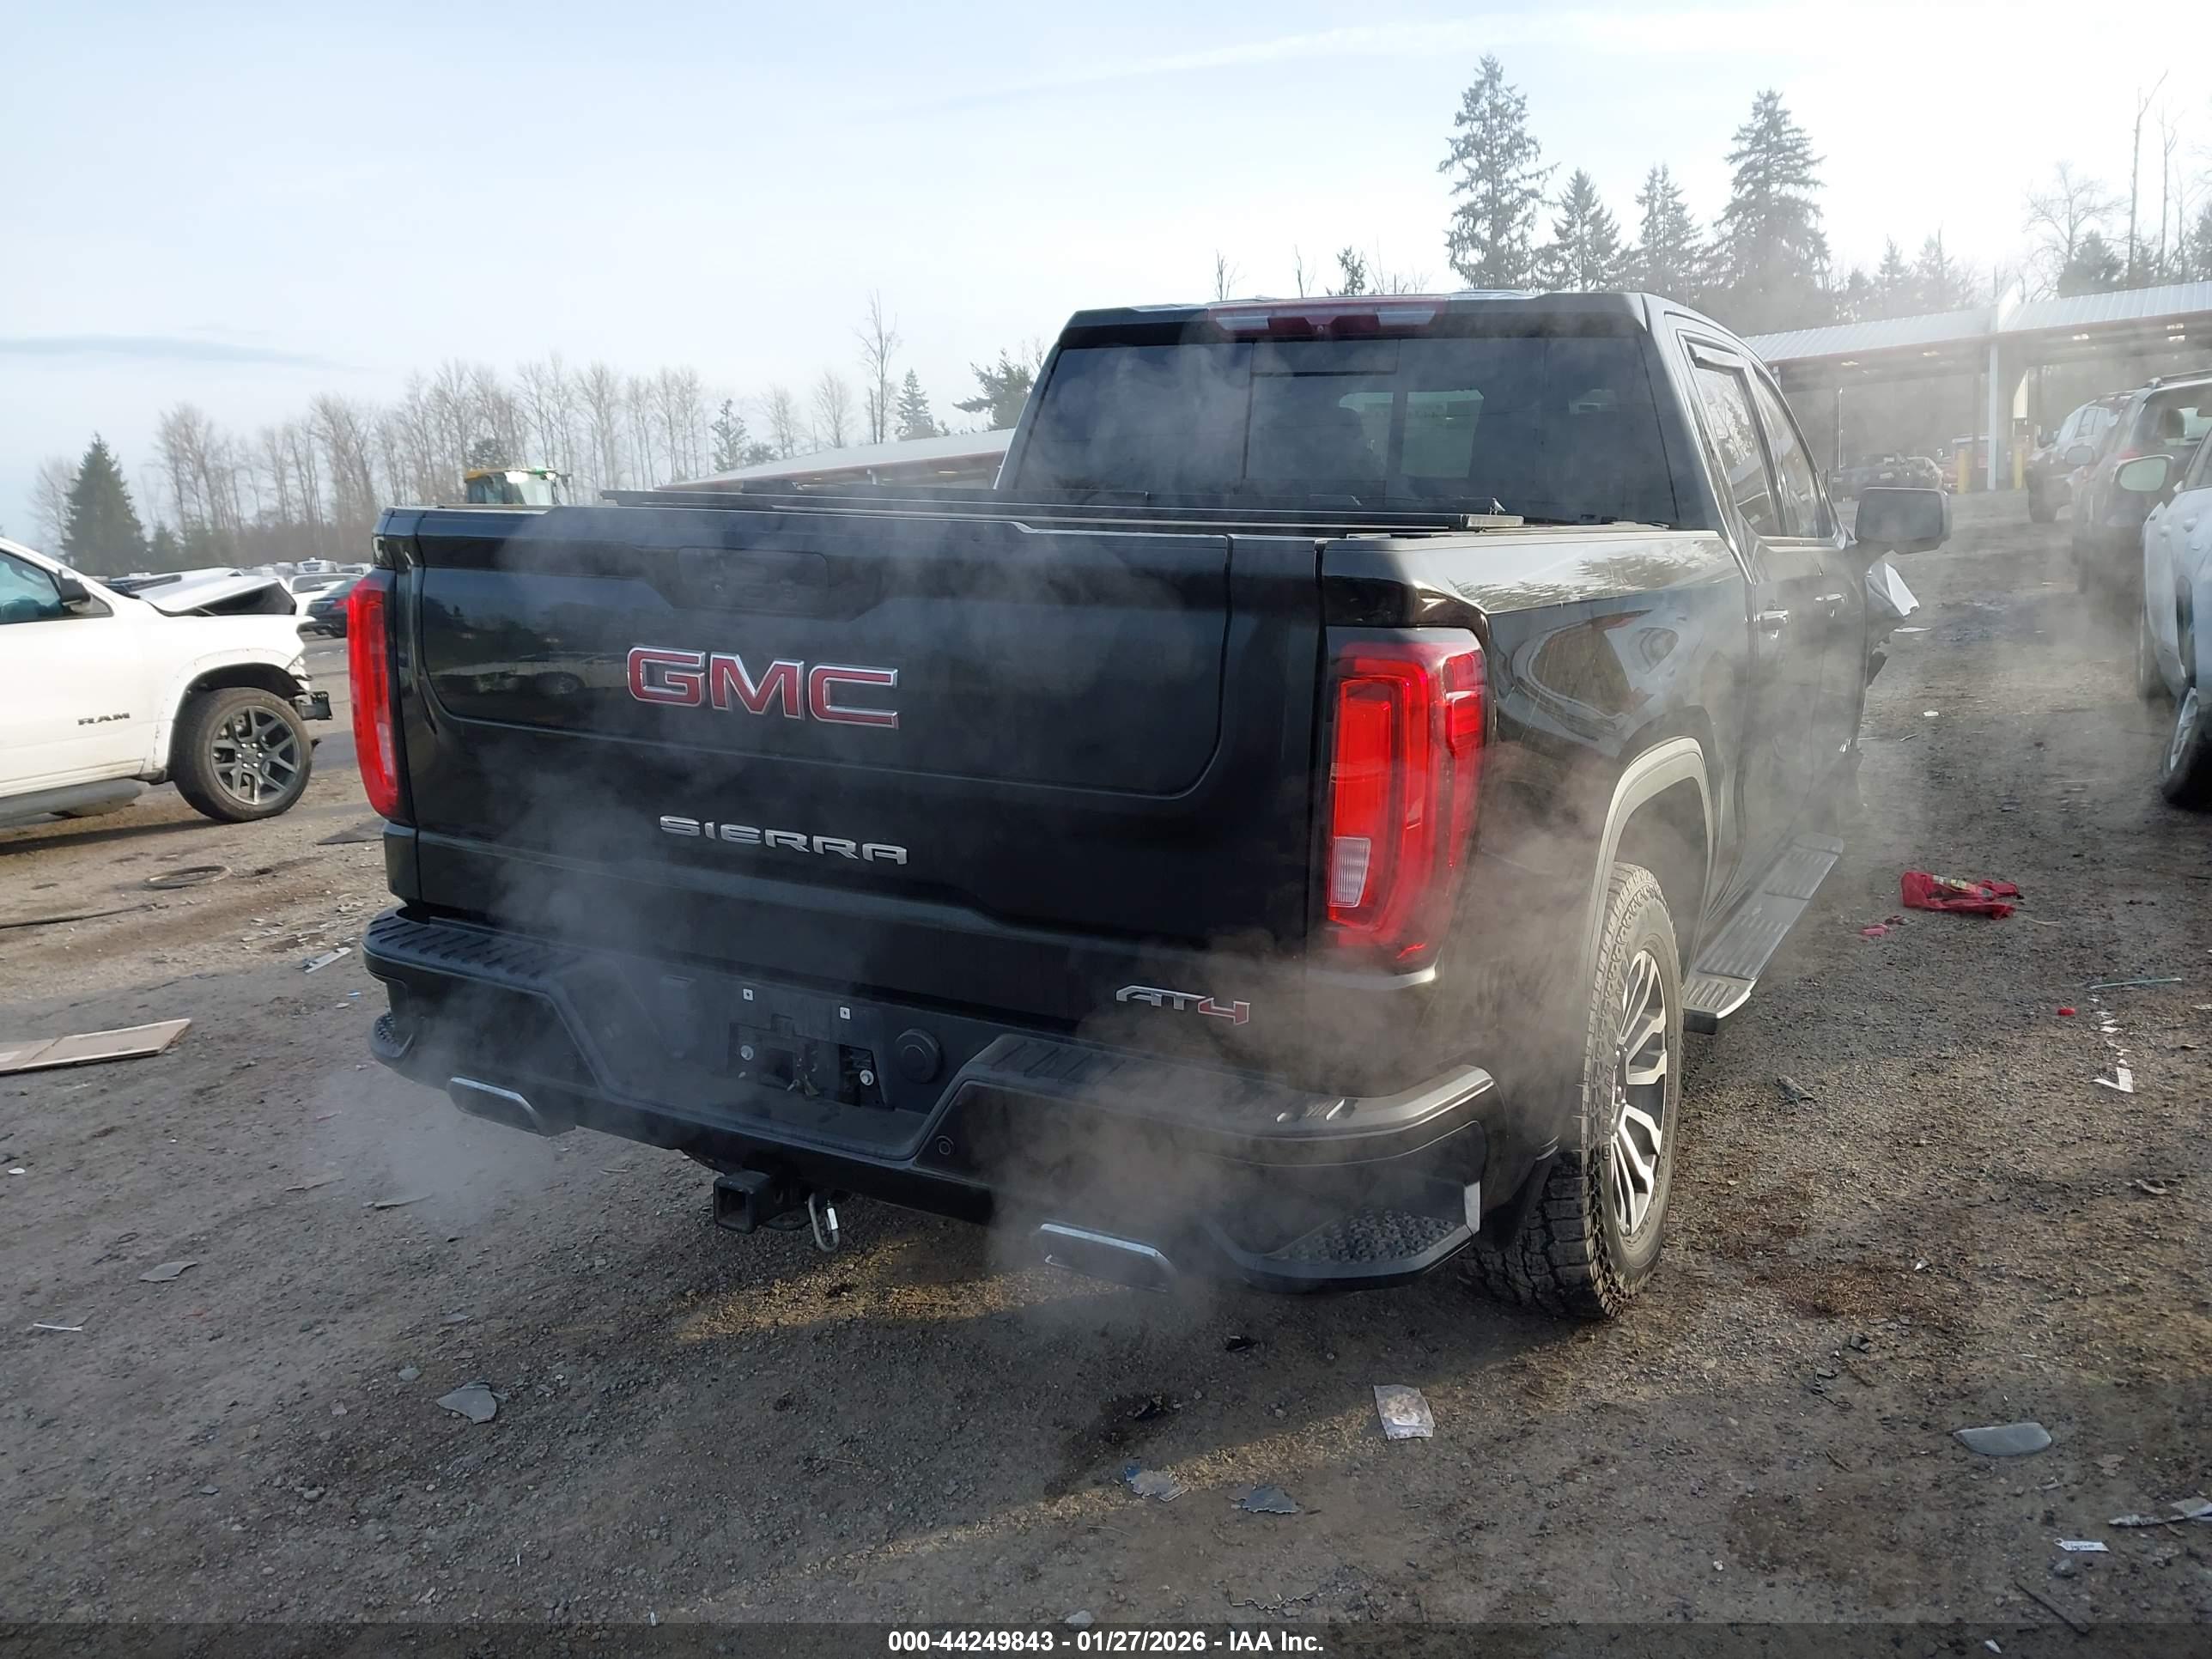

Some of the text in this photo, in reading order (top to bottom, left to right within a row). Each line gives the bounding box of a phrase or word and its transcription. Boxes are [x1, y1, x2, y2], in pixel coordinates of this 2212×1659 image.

[626, 644, 900, 730] GMC
[77, 712, 131, 726] RAM
[659, 815, 908, 866] SIERRA
[1115, 984, 1251, 1026] AT4
